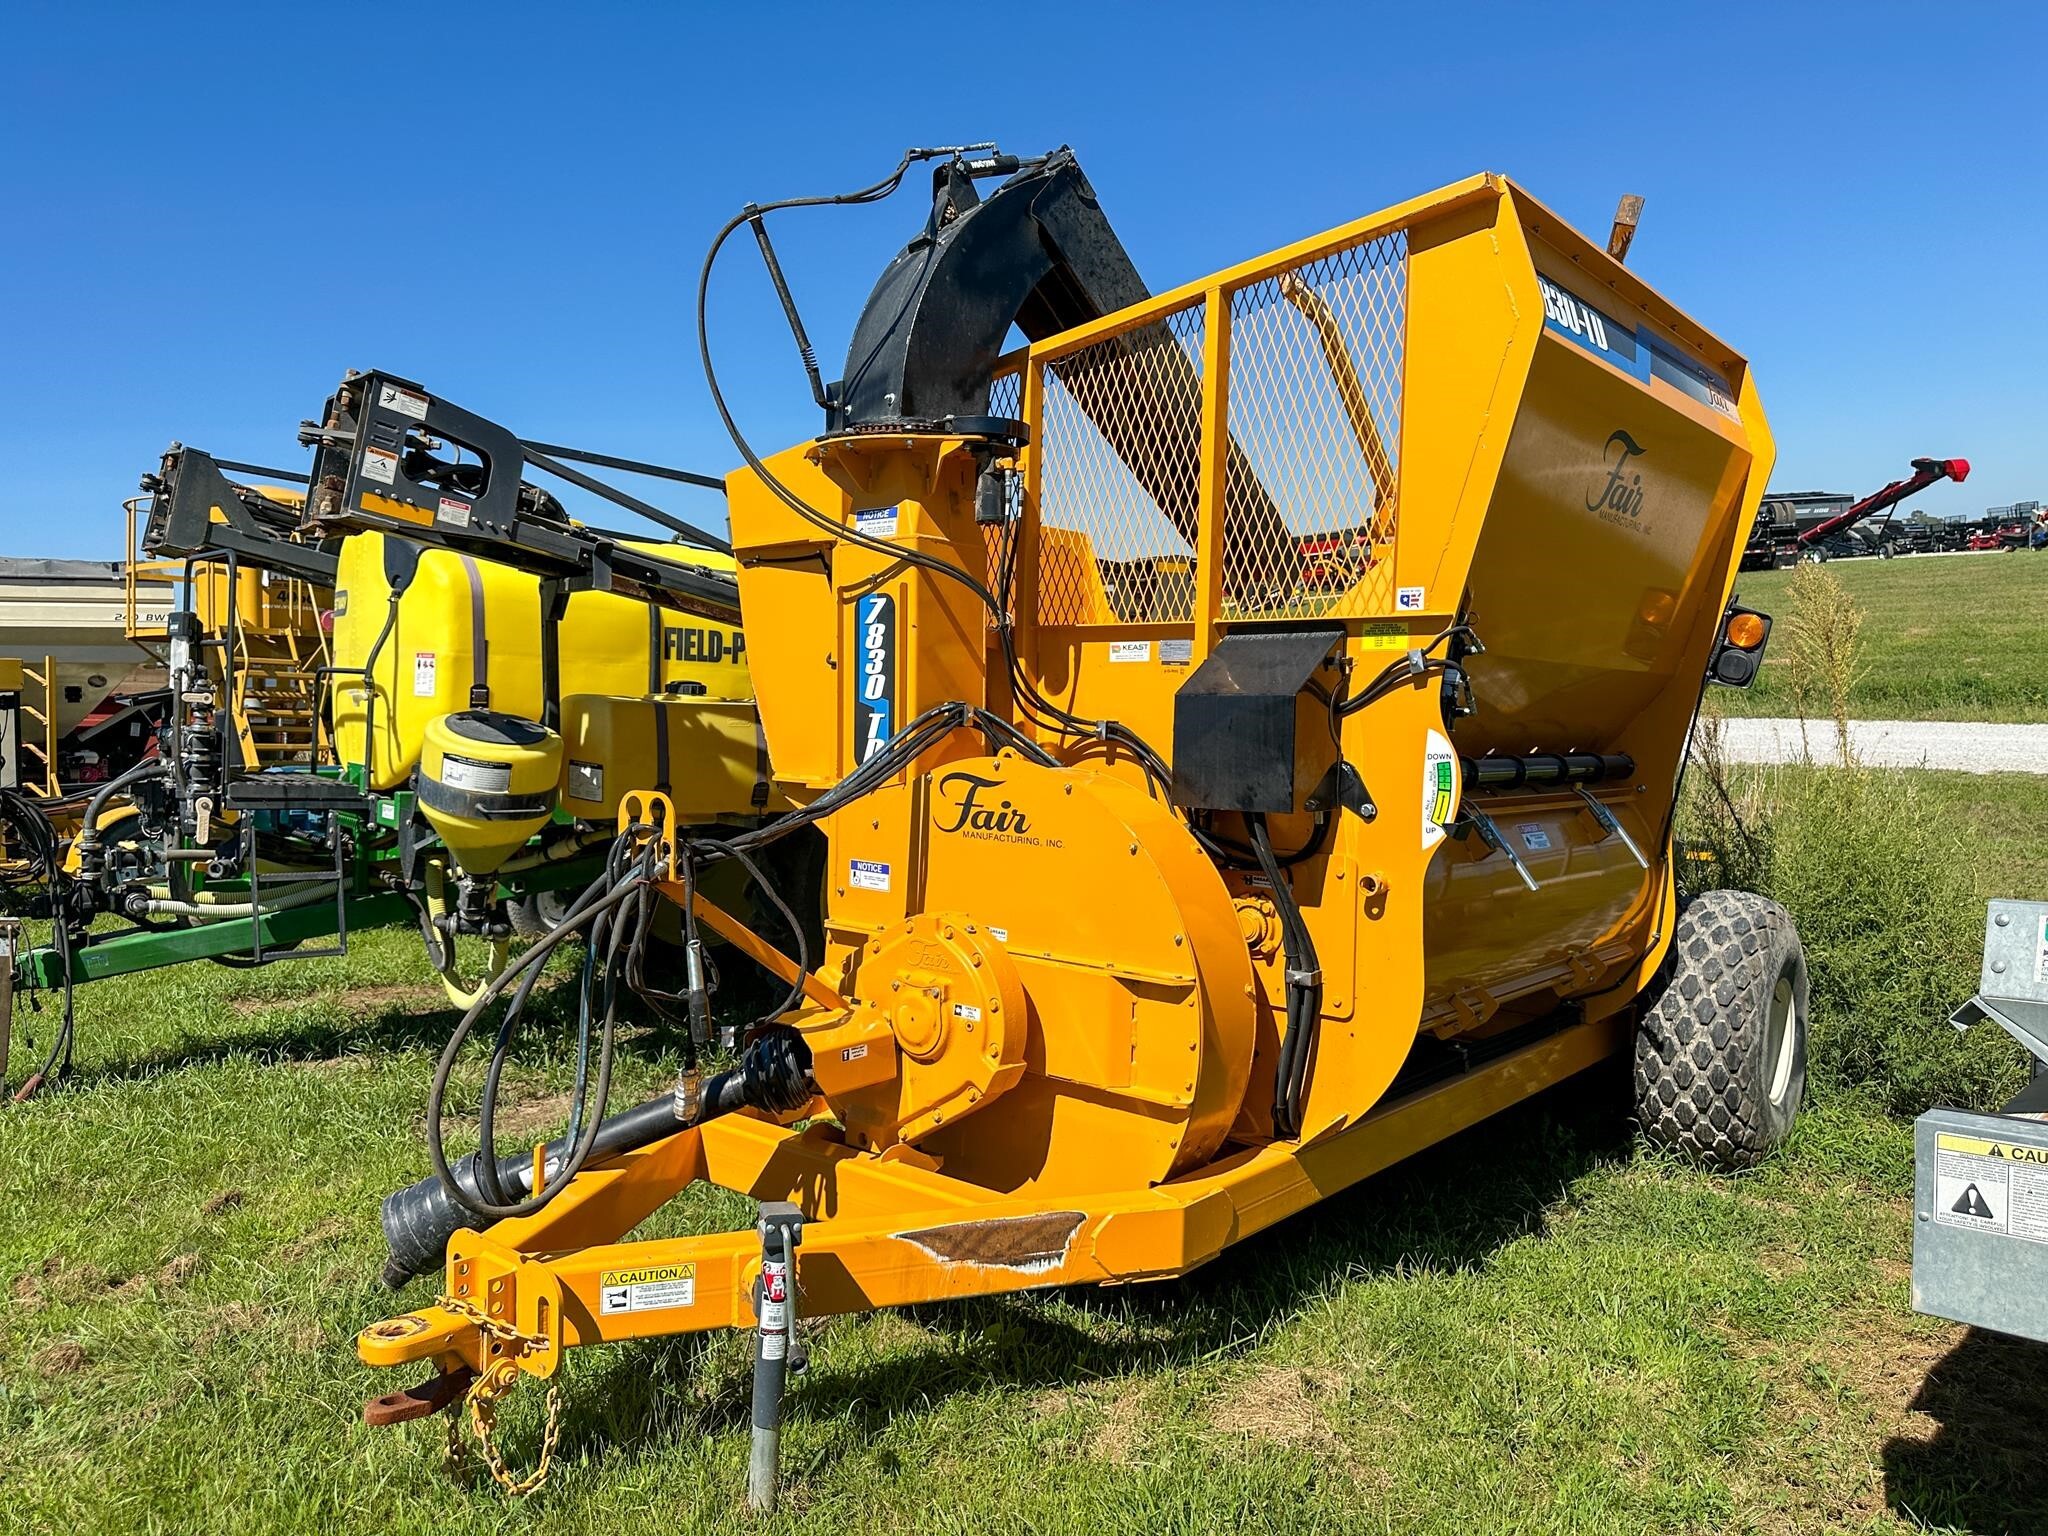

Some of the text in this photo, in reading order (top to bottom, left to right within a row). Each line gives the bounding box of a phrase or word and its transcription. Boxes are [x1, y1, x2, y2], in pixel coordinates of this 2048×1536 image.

[1586, 430, 1647, 517] Fair
[863, 509, 889, 519] NOTICE
[864, 597, 887, 700] 7830
[933, 772, 1032, 834] Fair
[1046, 840, 1065, 848] INC.
[858, 862, 882, 872] NOTICE
[620, 1268, 678, 1283] CAUTION
